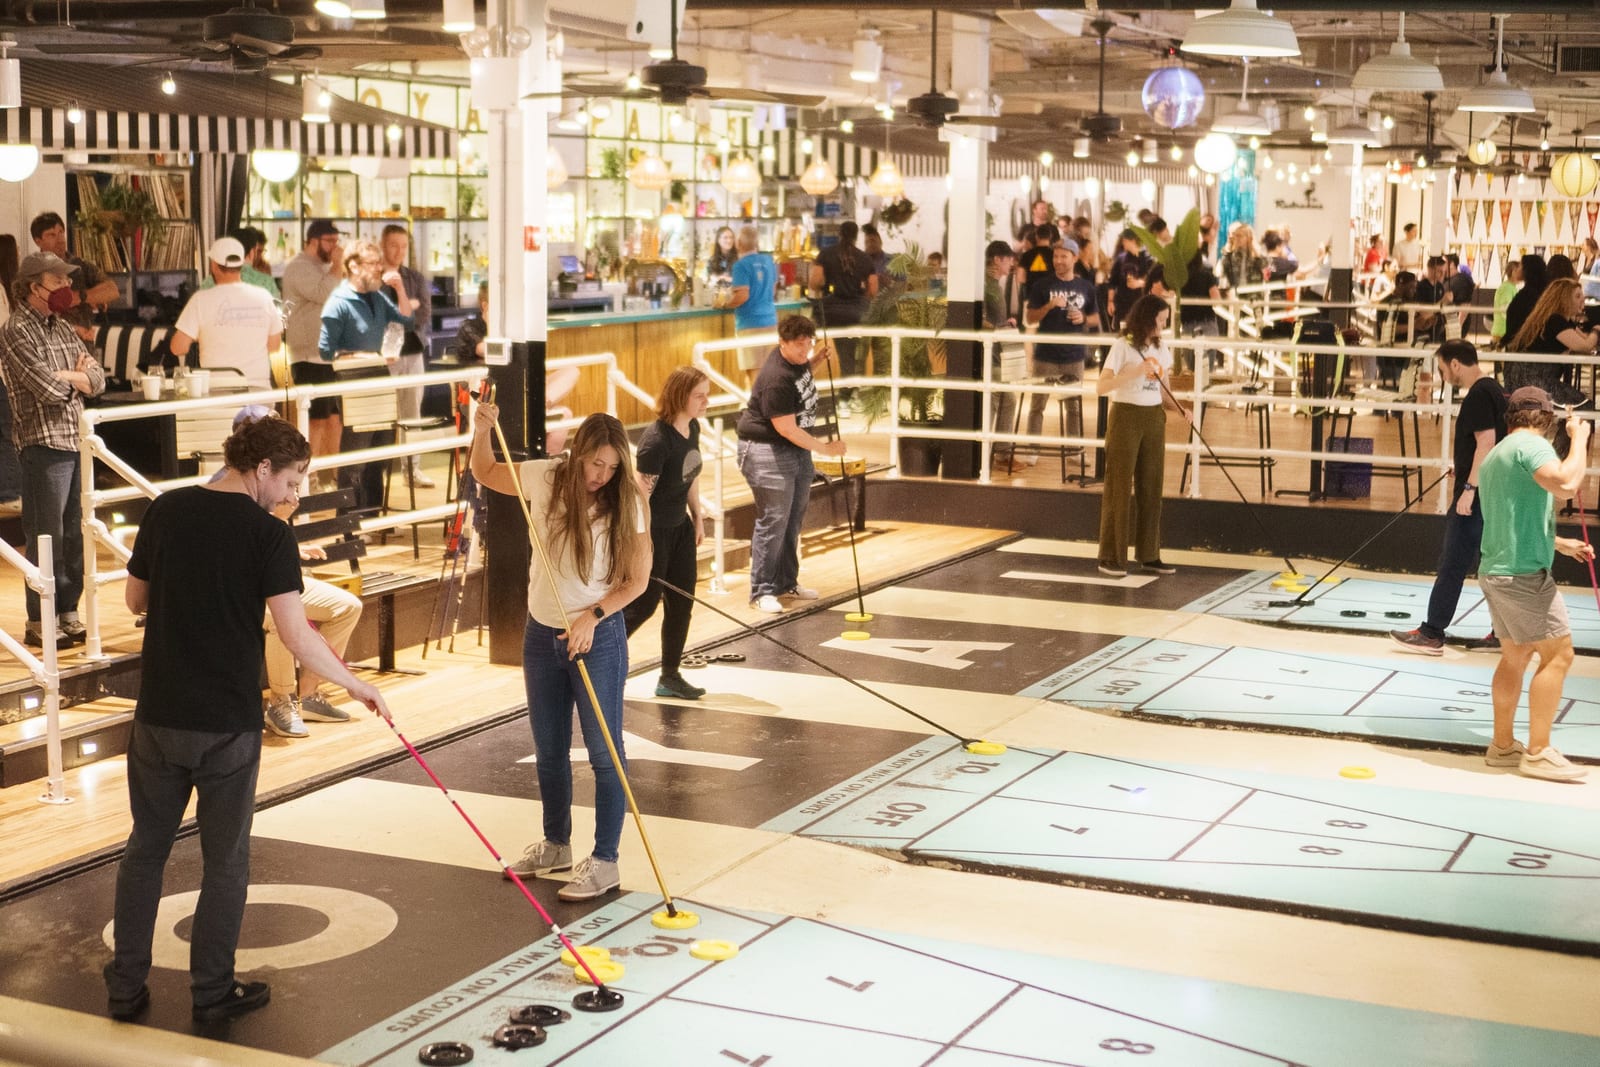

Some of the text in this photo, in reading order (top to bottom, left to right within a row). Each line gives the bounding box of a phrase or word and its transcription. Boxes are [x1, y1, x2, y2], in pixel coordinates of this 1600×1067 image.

[1152, 652, 1187, 662] 10
[1095, 680, 1142, 696] OFF
[955, 760, 1001, 774] 10
[800, 749, 931, 815] DO NOT WALK ON COURTS
[864, 802, 927, 827] OFF
[1324, 820, 1368, 829] 8
[1299, 845, 1343, 855] 8
[1506, 852, 1552, 869] 10
[580, 916, 613, 930] DO
[633, 935, 696, 957] 10
[493, 950, 549, 976] WALK
[461, 977, 498, 995] ON
[826, 976, 875, 992] 7
[386, 995, 464, 1033] COURTS
[1098, 1038, 1155, 1055] 8
